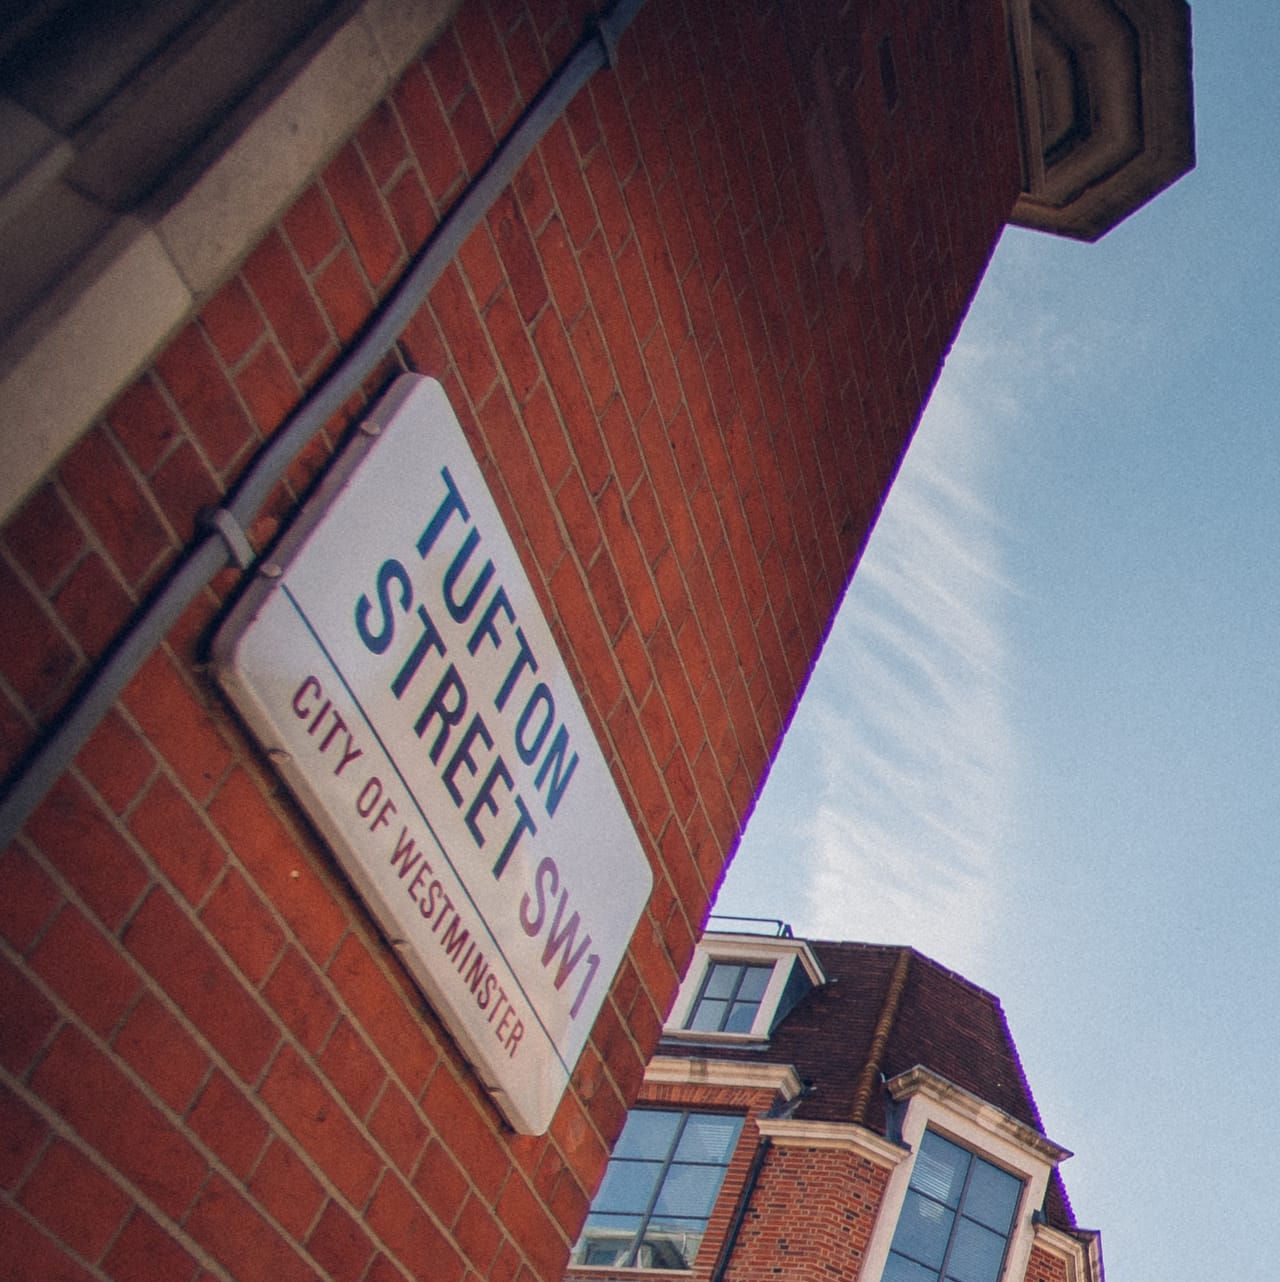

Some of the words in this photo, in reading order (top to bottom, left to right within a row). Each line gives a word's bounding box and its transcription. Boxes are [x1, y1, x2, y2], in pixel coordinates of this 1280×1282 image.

[354, 558, 538, 881] STREET
[519, 856, 601, 1021] SW1
[415, 465, 580, 819] TUFTON
[292, 675, 363, 777] CITY
[356, 776, 398, 833] OF
[390, 826, 526, 1059] WESTMINSTER
